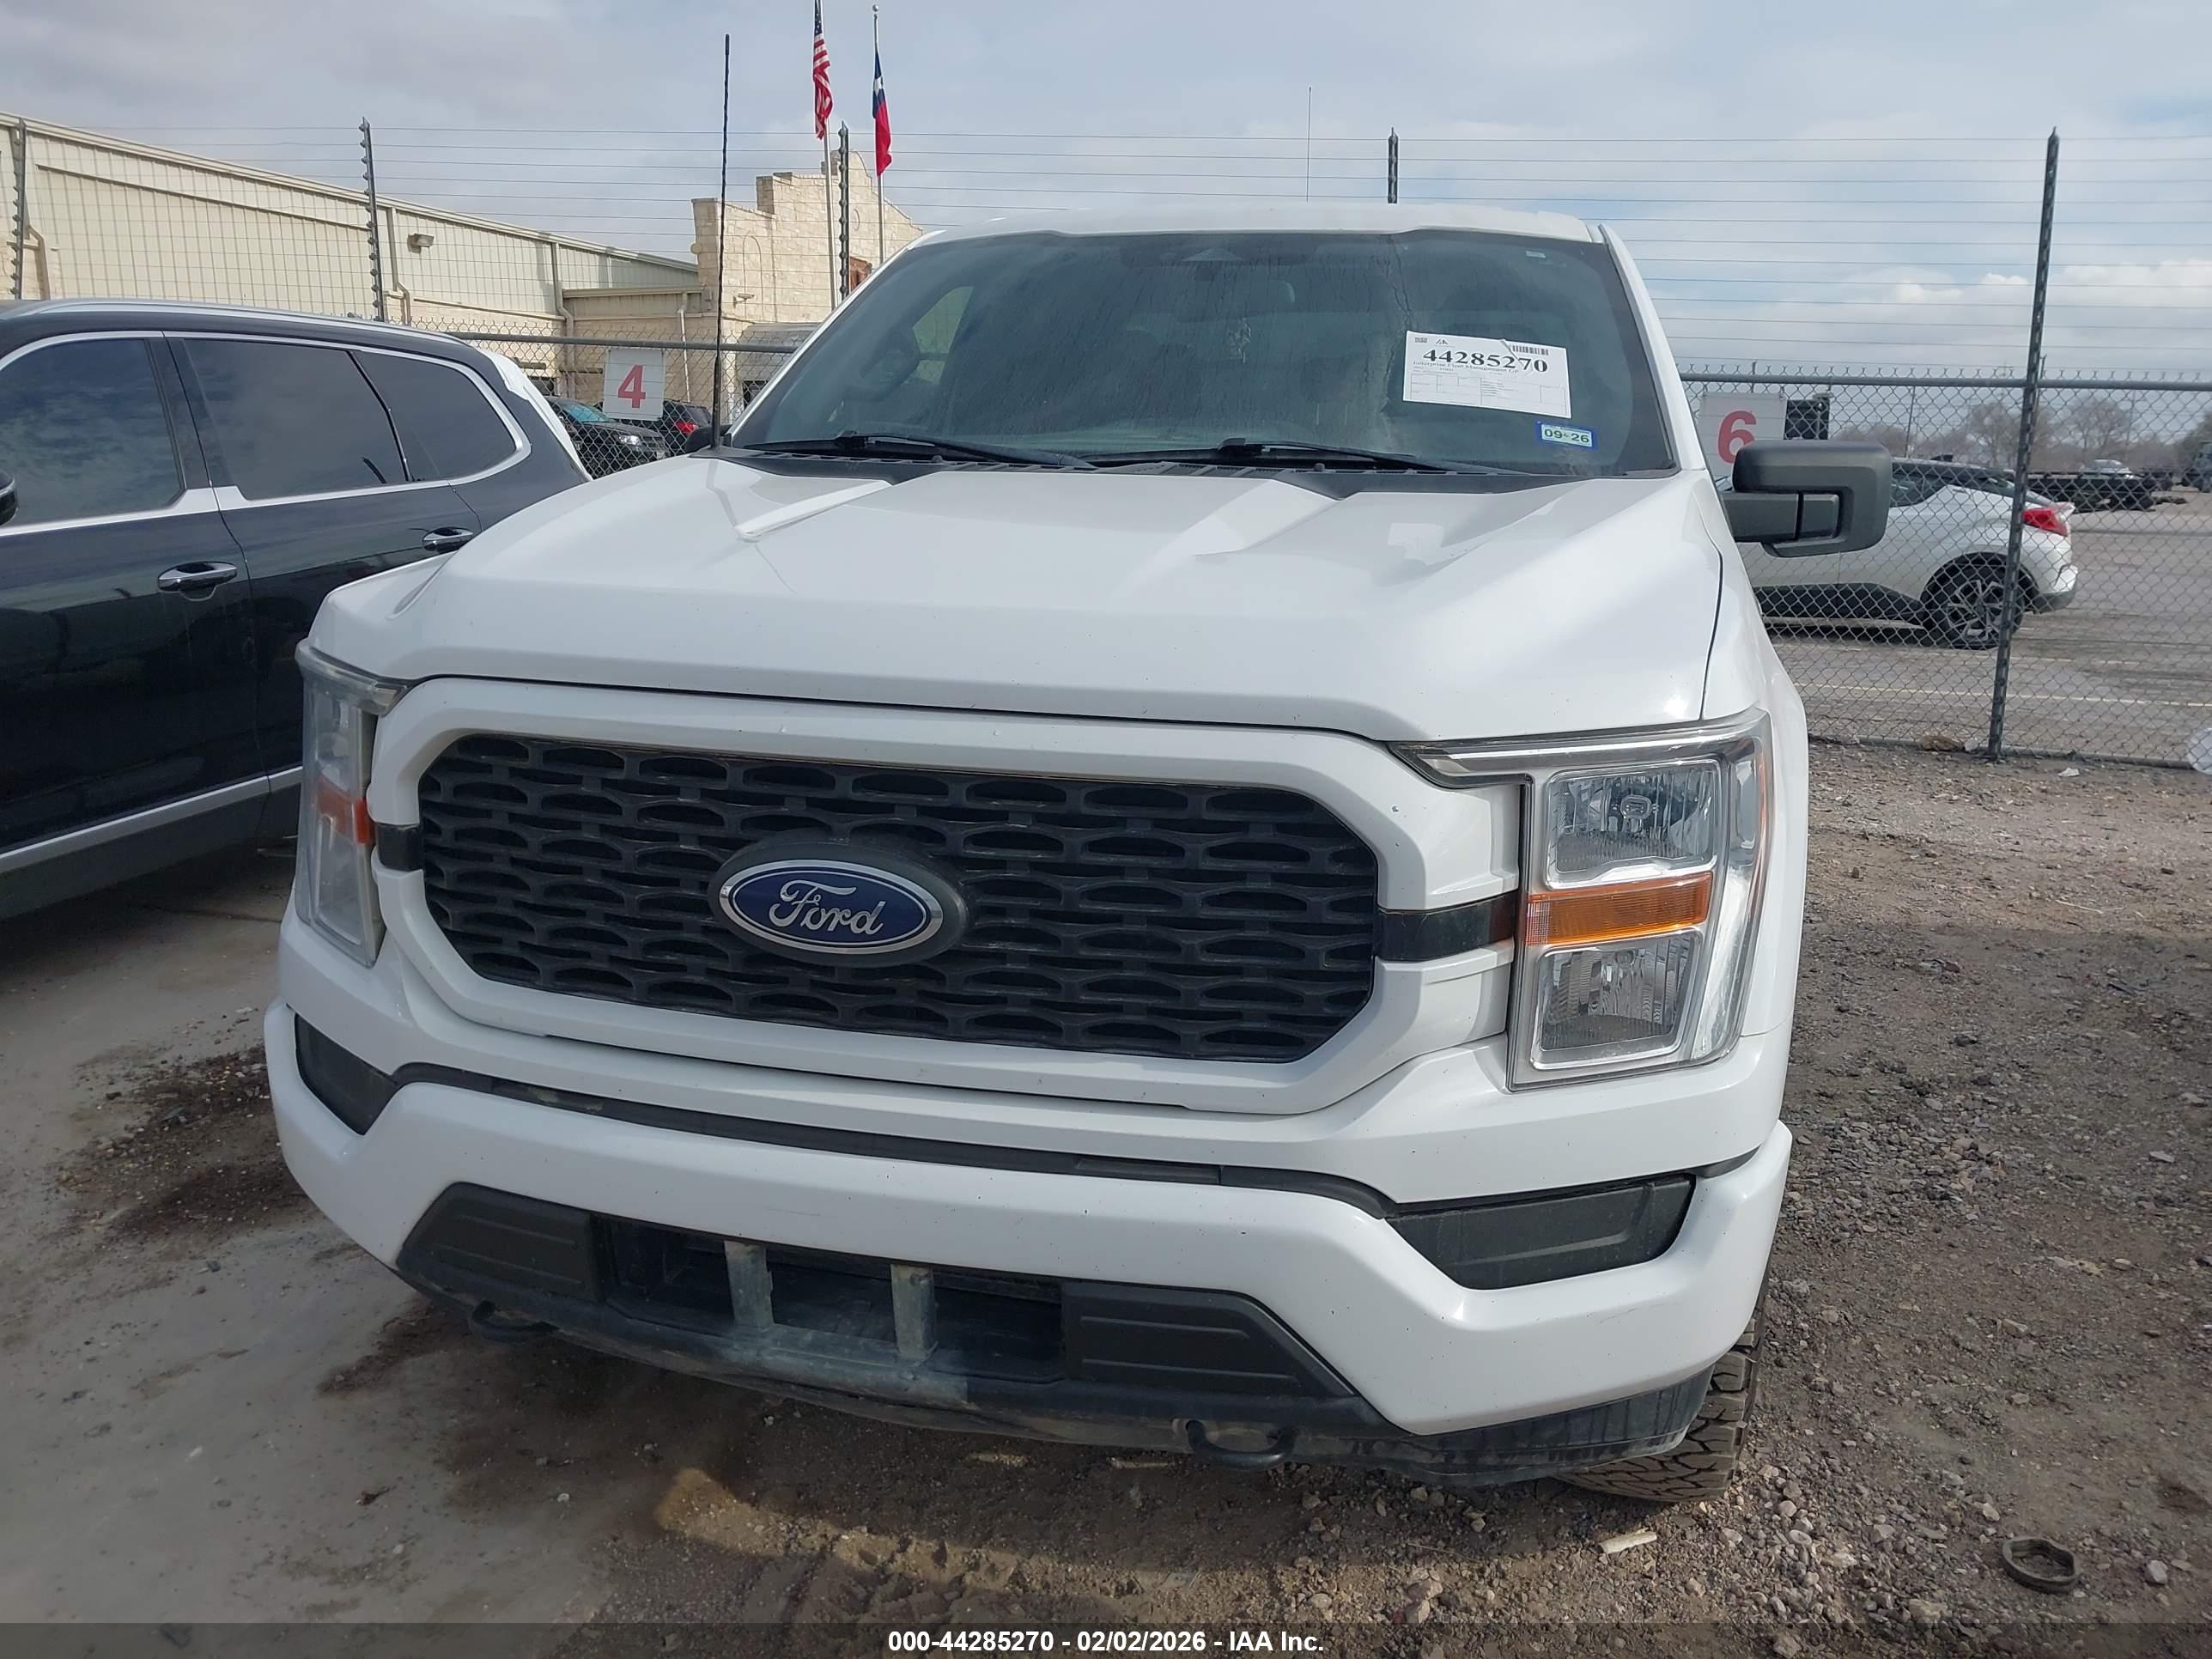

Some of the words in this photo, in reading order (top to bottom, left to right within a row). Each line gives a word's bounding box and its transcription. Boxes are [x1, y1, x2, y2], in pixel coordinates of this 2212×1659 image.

[1423, 349, 1548, 373] 44285270
[617, 365, 646, 409] 4
[1544, 428, 1564, 439] 09
[1571, 433, 1590, 443] 26
[1718, 410, 1757, 464] 6
[769, 879, 886, 935] Ford
